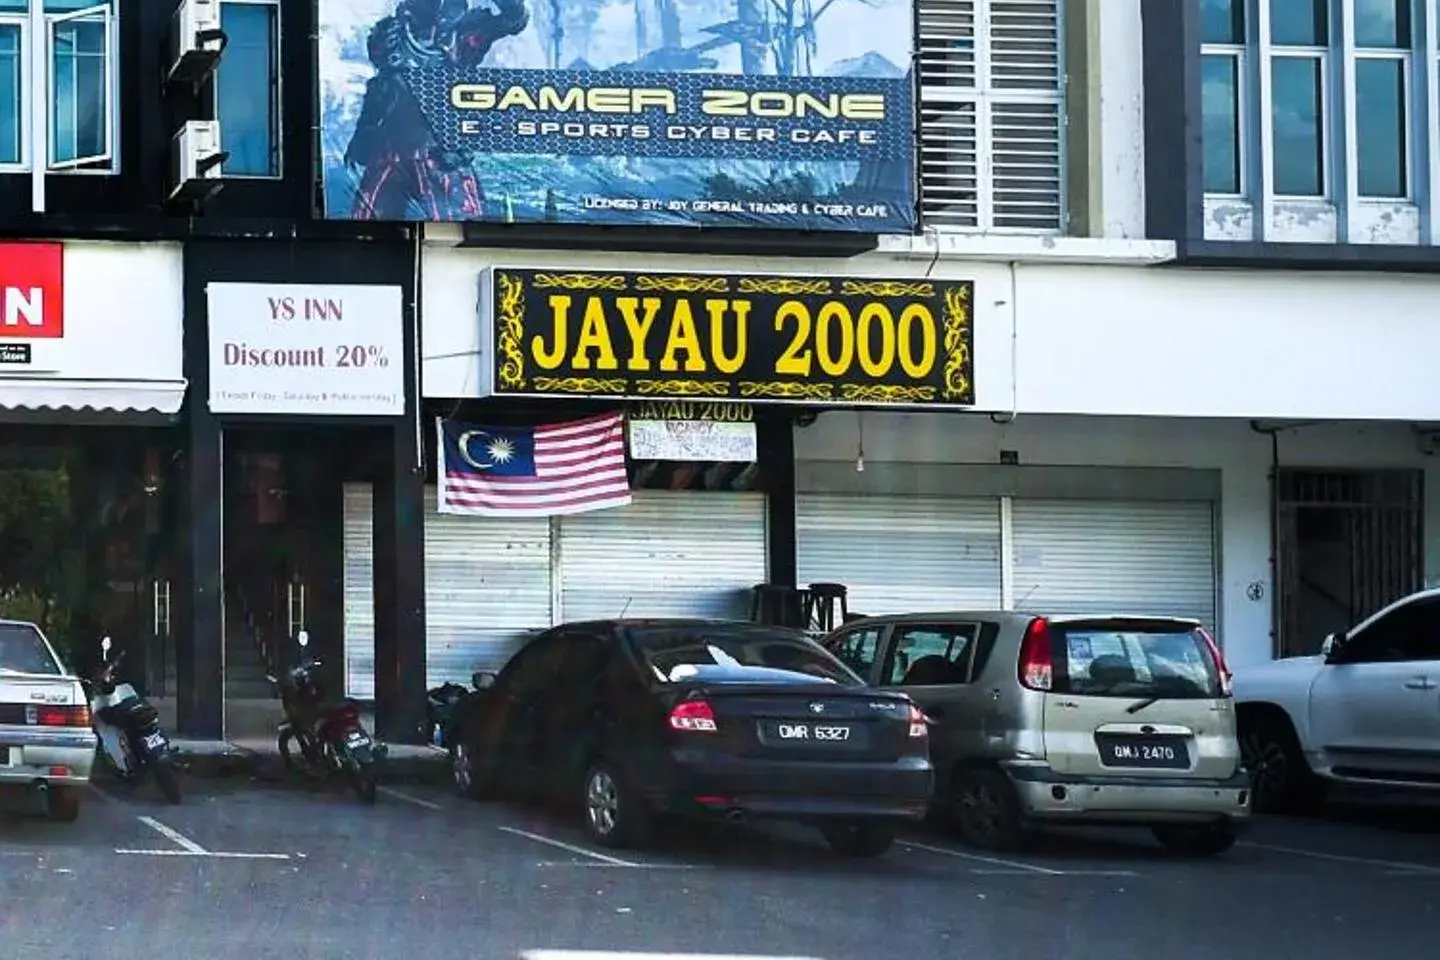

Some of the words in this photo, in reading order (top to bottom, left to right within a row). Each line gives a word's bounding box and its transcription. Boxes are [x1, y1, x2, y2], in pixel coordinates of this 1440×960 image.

[450, 84, 675, 114] GAMER
[702, 88, 885, 120] ZONE
[461, 122, 478, 135] E
[517, 123, 650, 139] SPORTS
[667, 127, 776, 142] CYBER
[790, 129, 878, 144] CAFE
[267, 297, 295, 321] YS
[304, 298, 343, 321] INN
[531, 295, 752, 374] JAYAU
[773, 300, 937, 379] 2000
[223, 343, 325, 368] Discount
[335, 345, 389, 369] 20%
[700, 401, 754, 421] 2000
